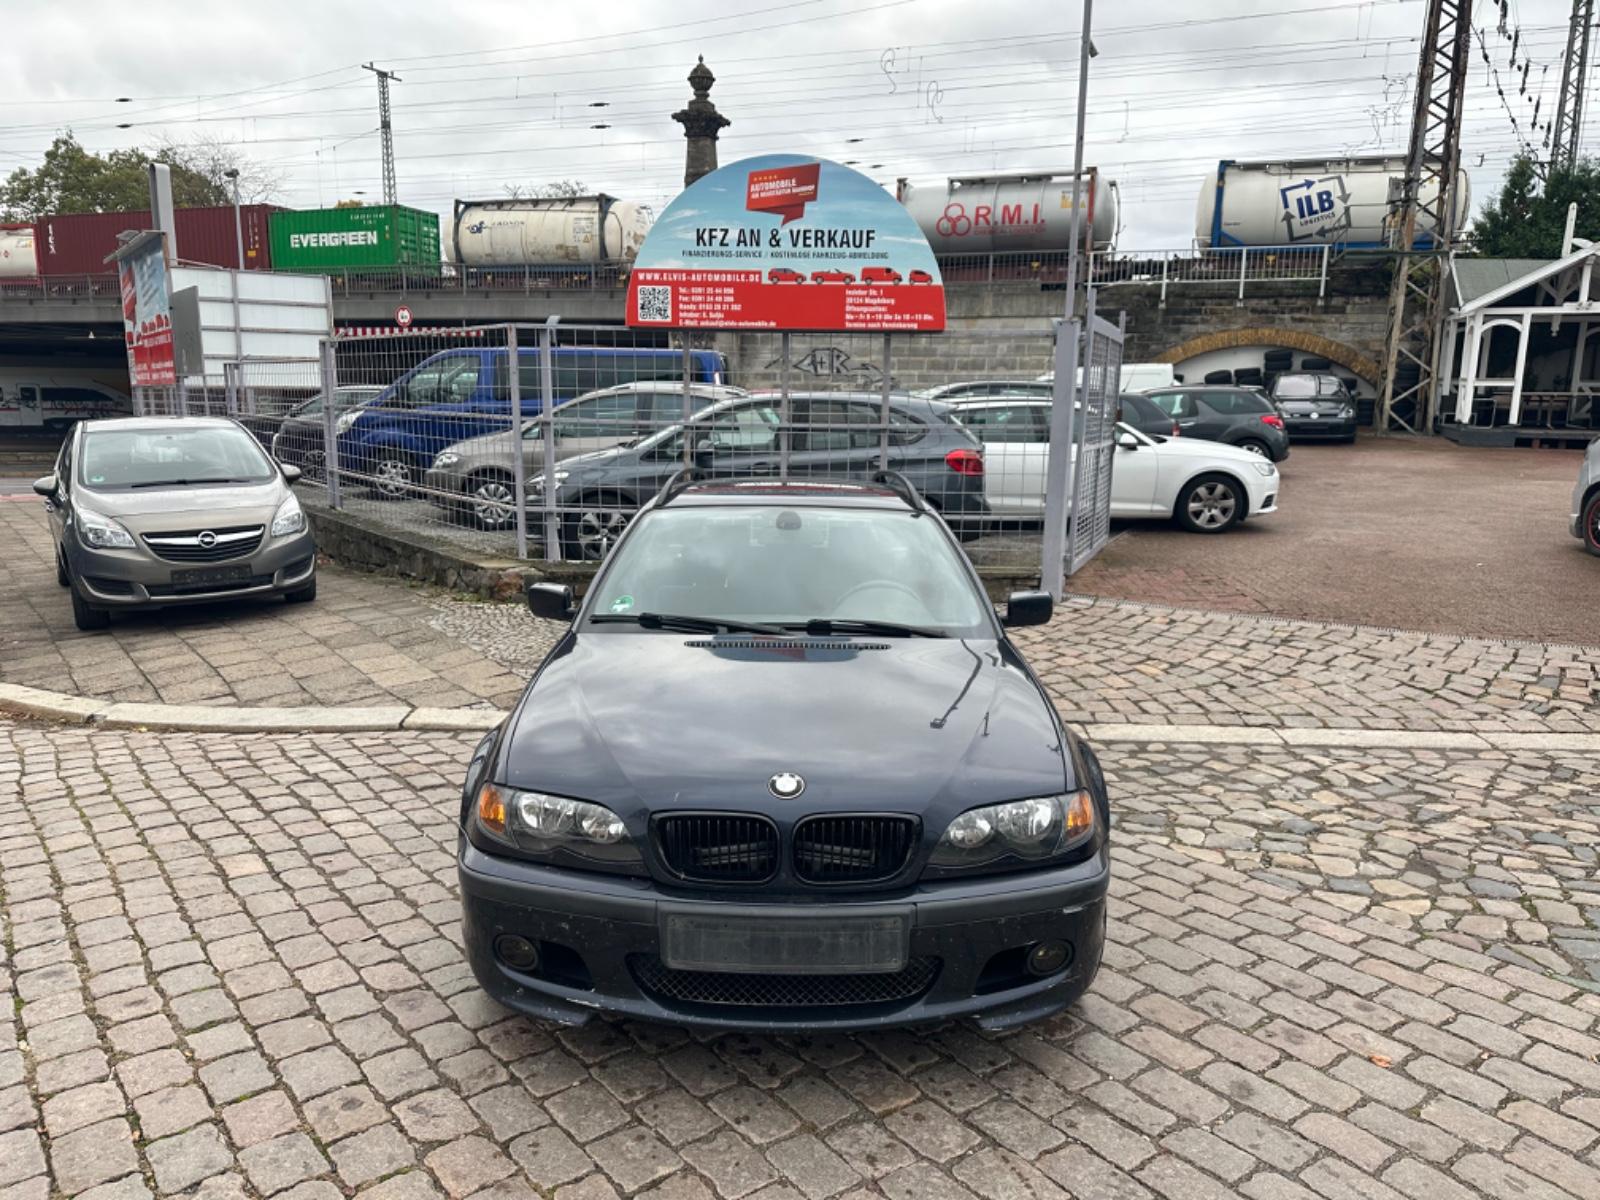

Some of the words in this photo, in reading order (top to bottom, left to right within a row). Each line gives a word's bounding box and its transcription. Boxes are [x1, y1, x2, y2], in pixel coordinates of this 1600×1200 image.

[751, 178, 797, 193] AUTOMOBILE
[1296, 190, 1334, 219] ILB
[974, 203, 1046, 226] R.M.I.
[1300, 212, 1336, 226] LOGISTICS
[290, 231, 378, 248] EVERGREEN
[696, 228, 729, 247] KFZ
[736, 228, 761, 247] AN
[769, 229, 781, 248] &
[789, 228, 876, 248] VERKAUF
[682, 250, 763, 259] FINANZIERUNGS-SERVICE
[770, 250, 810, 259] KOSTENLOSE
[812, 251, 889, 259] FAHRZEUG-ABMELDUNG
[637, 272, 760, 281] WWW.ELVIS-AUTOMOBILE.DE
